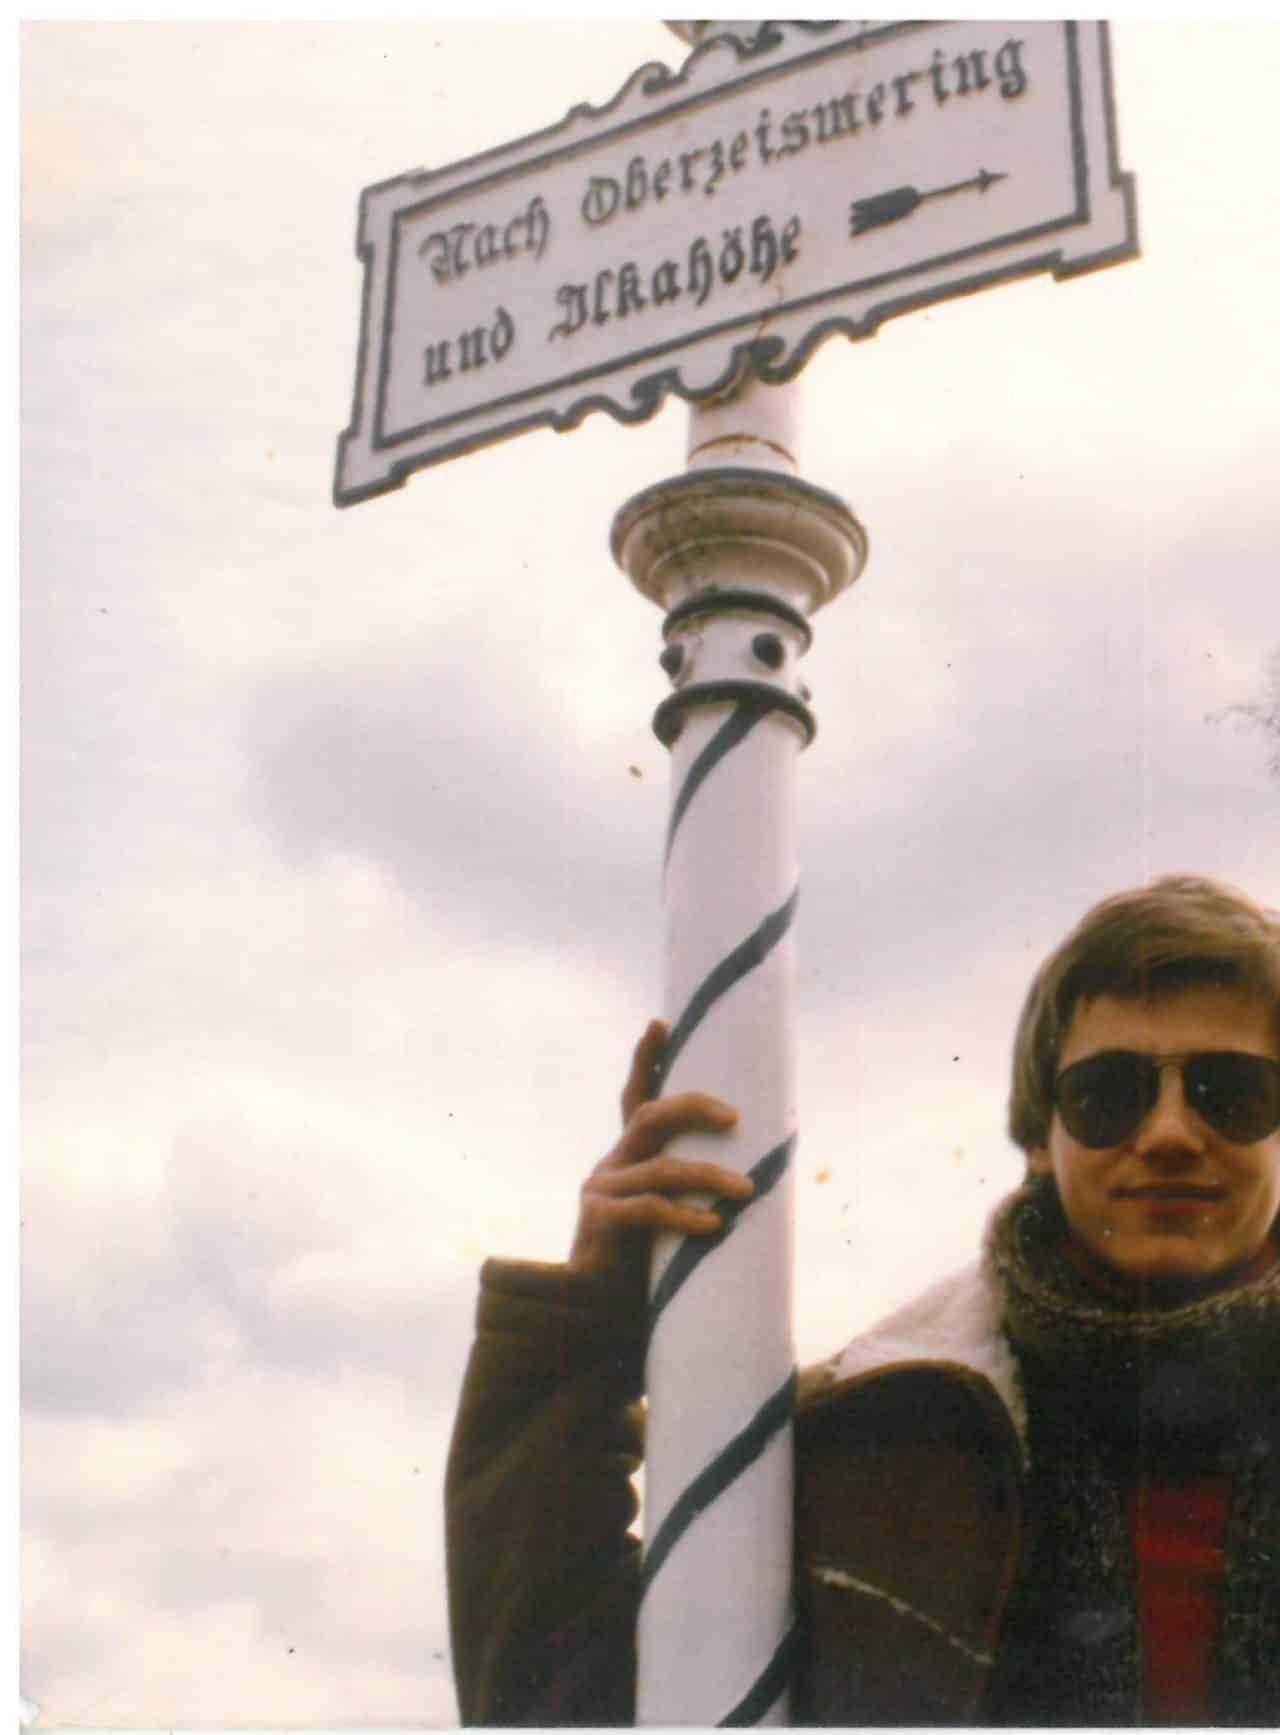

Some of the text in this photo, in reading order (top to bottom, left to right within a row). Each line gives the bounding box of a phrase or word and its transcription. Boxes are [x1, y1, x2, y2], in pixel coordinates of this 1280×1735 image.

[419, 38, 1027, 285] Nach Oberzeismering
[423, 306, 515, 387] und
